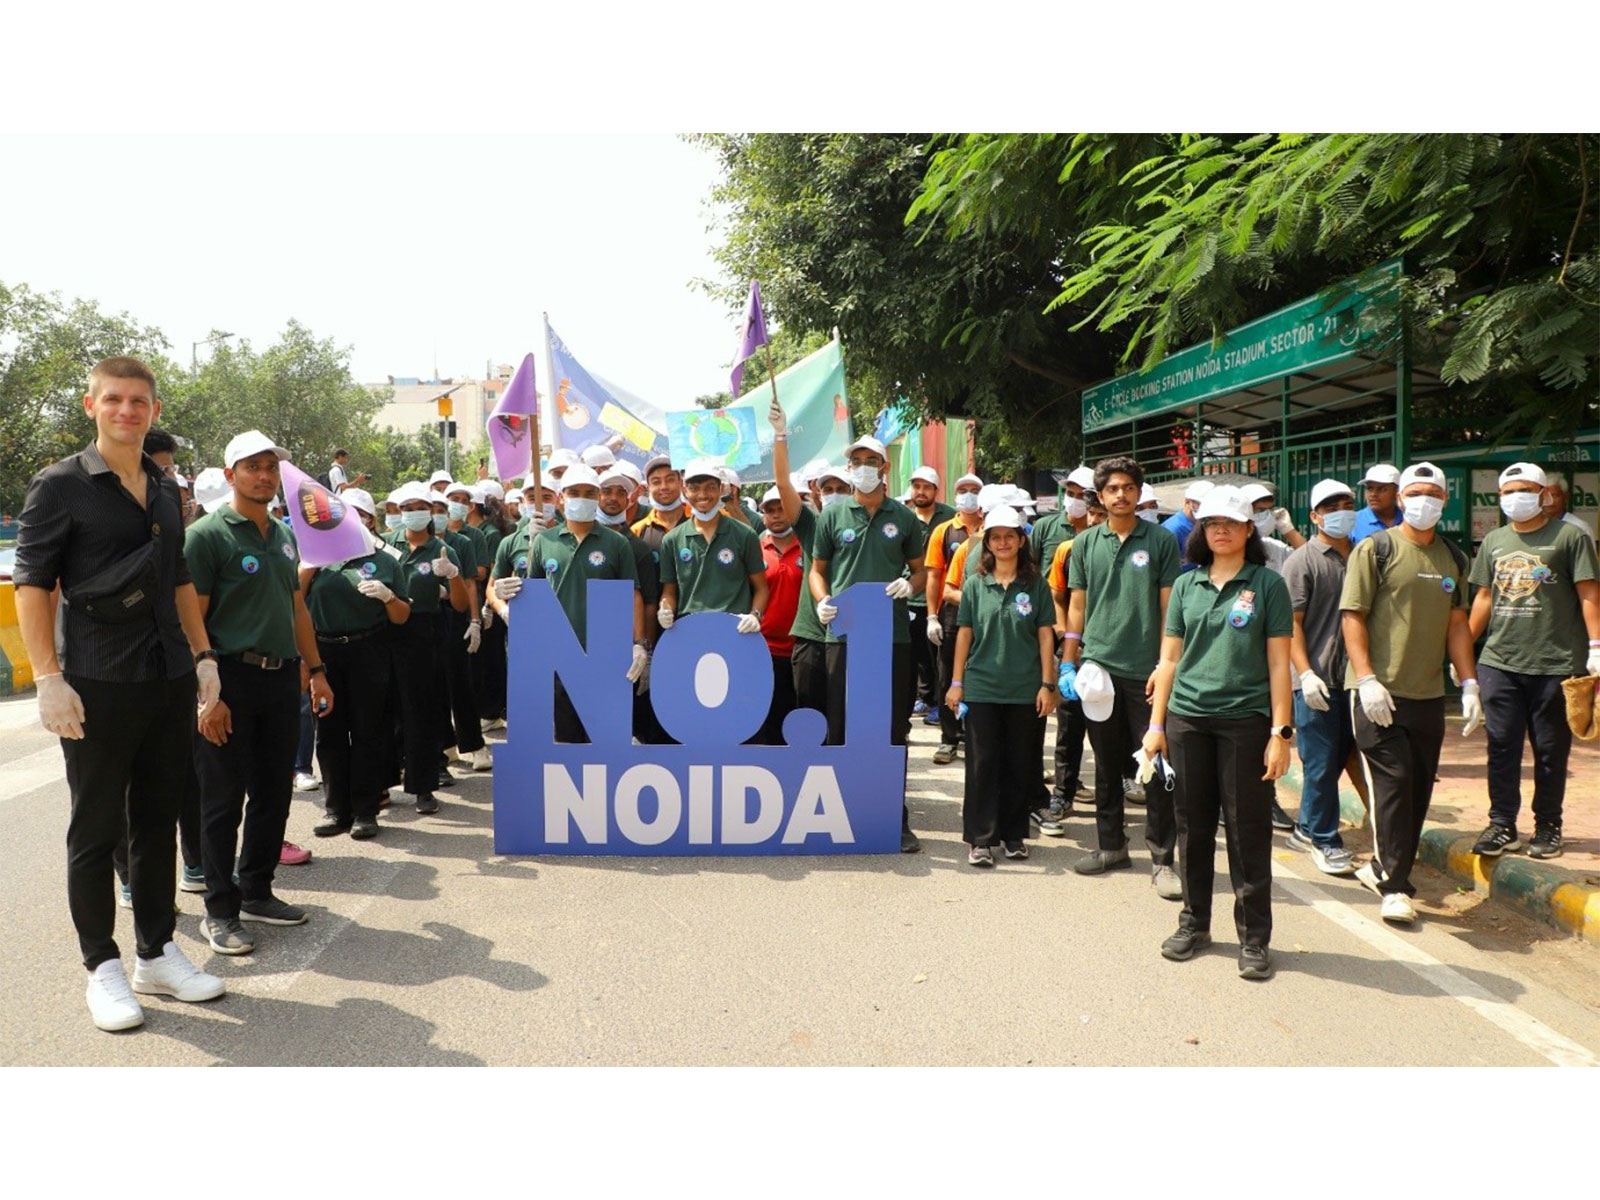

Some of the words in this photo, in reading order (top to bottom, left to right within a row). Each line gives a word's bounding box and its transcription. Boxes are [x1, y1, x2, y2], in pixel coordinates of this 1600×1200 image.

[1131, 379, 1161, 402] DOCKING
[1162, 367, 1194, 392] STATION
[1195, 358, 1222, 380] NOIDA
[1224, 341, 1269, 371] STADIUM,
[1270, 322, 1315, 355] SECTOR
[303, 494, 320, 525] WORLD
[506, 578, 894, 746] No.1
[543, 762, 856, 846] NOIDA
